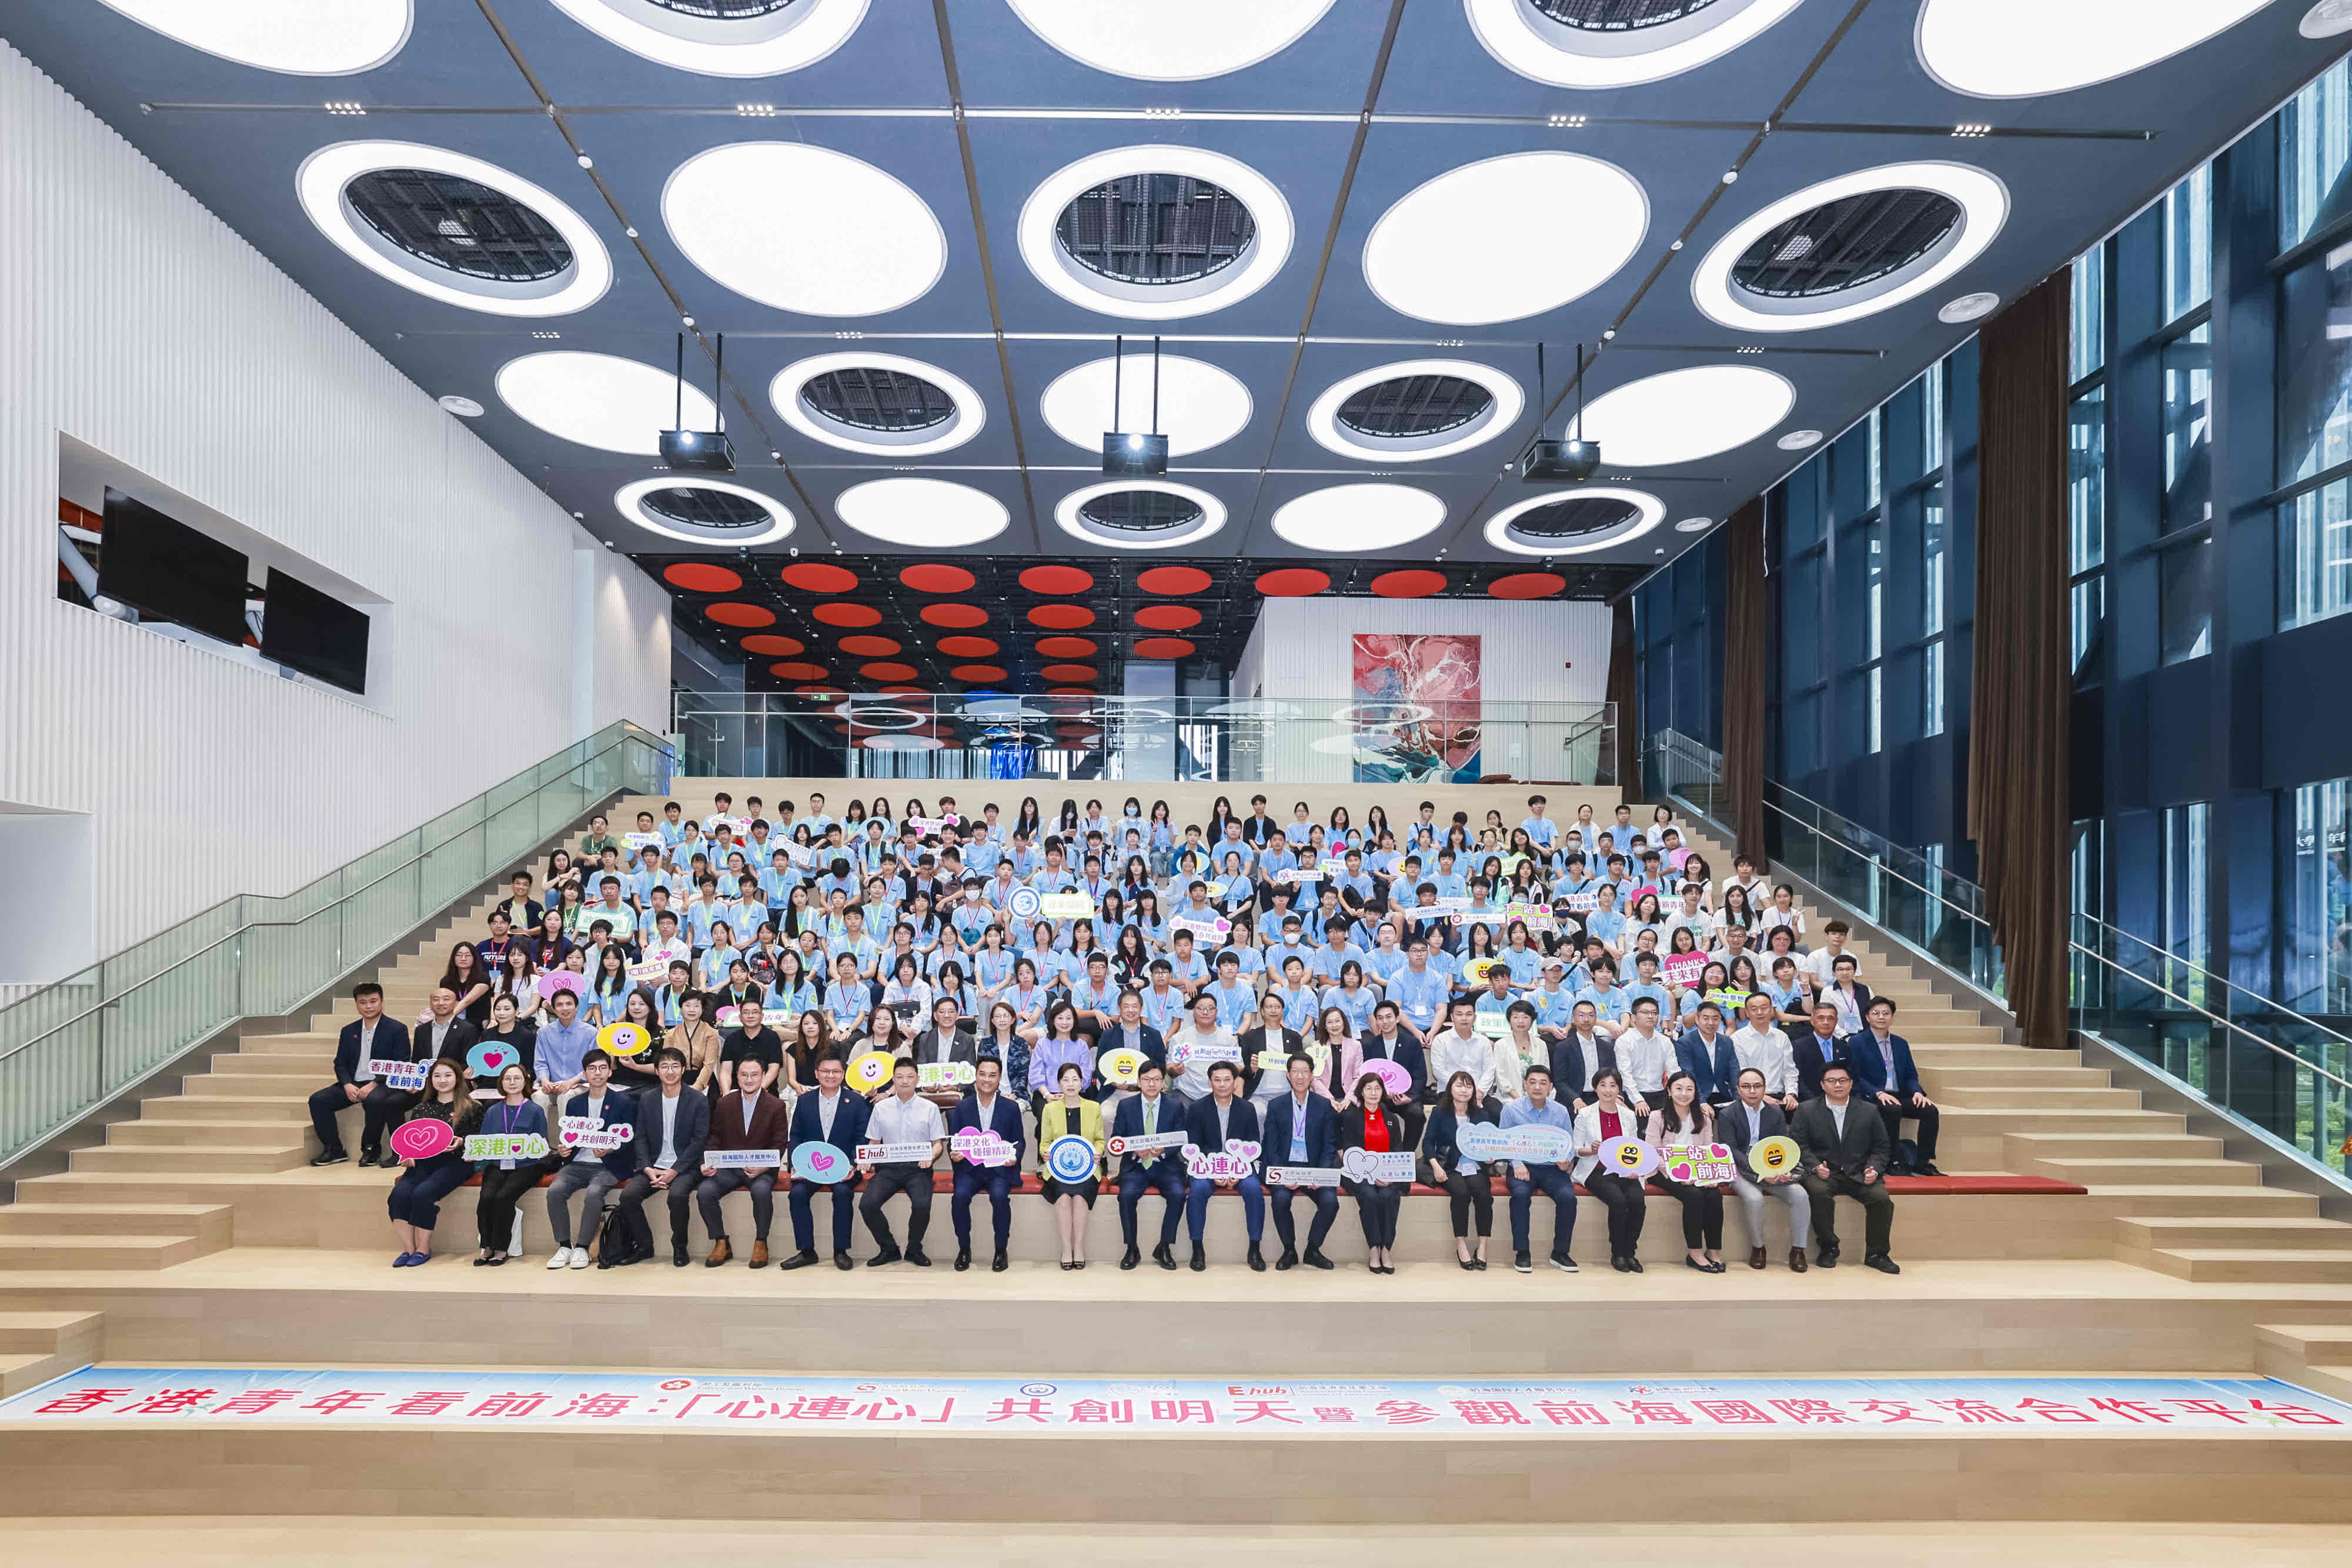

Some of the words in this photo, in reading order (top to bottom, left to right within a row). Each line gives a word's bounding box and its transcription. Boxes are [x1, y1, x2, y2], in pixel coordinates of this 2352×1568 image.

[1669, 958, 1706, 970] THANKS
[1665, 968, 1703, 981] 未來有
[371, 1062, 415, 1075] 香港青年
[389, 1075, 423, 1088] 看前海
[580, 1134, 617, 1145] 共創明天
[954, 1138, 990, 1148] 深港文化
[467, 1138, 545, 1156] 深港同心
[1191, 1156, 1248, 1175] 心連心
